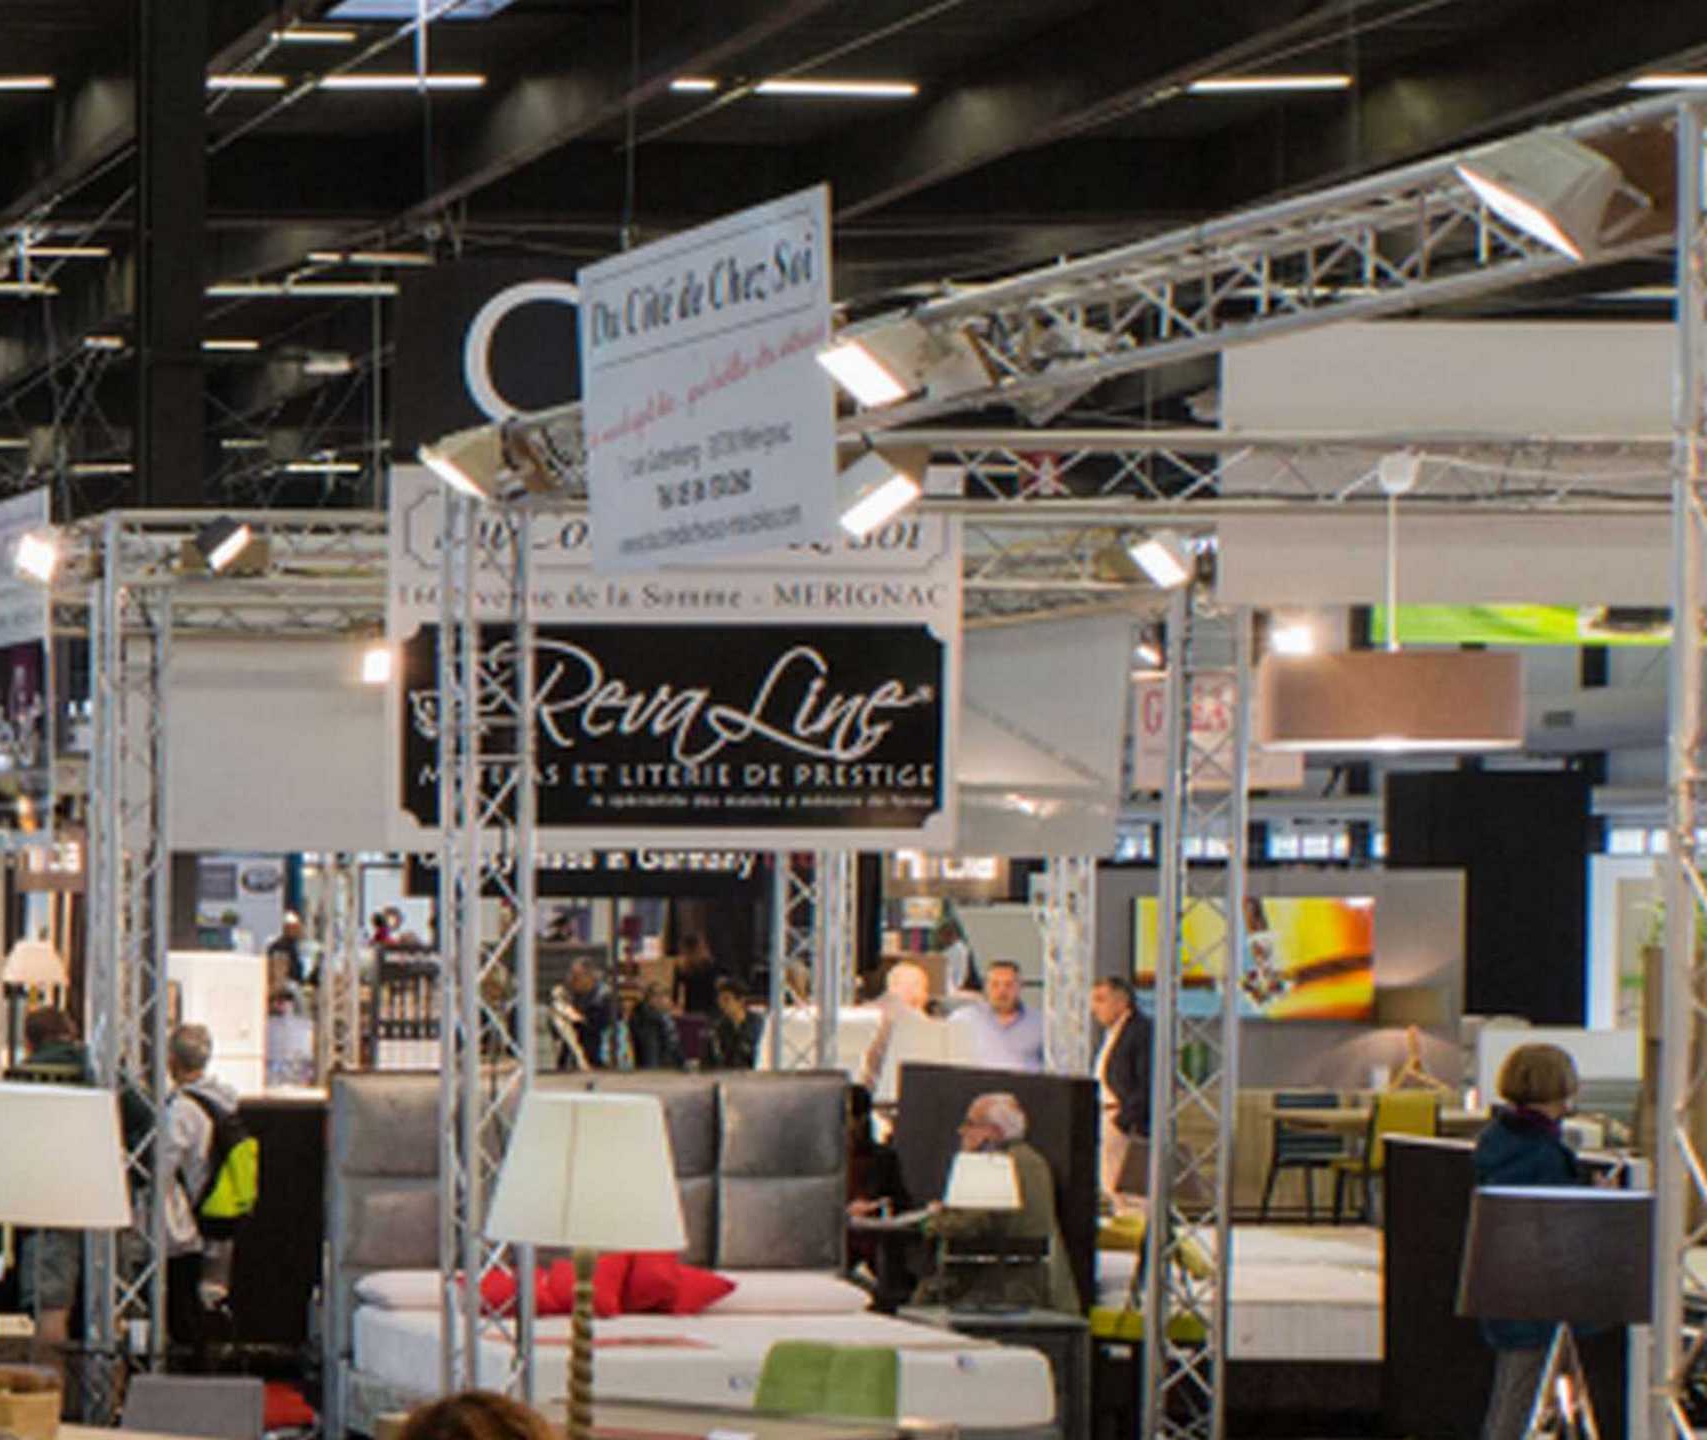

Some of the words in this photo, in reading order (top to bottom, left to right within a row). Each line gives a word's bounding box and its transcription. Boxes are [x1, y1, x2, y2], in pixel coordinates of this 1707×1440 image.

[708, 256, 769, 311] Chez
[774, 231, 813, 294] Soi
[465, 281, 581, 424] C
[567, 583, 597, 608] de
[606, 583, 630, 607] la
[642, 583, 740, 607] Somme
[774, 583, 948, 607] MERIGNAC
[573, 763, 605, 786] ET
[620, 763, 730, 786] LITERIE
[745, 763, 781, 786] DE
[795, 763, 934, 786] PRESTIGE
